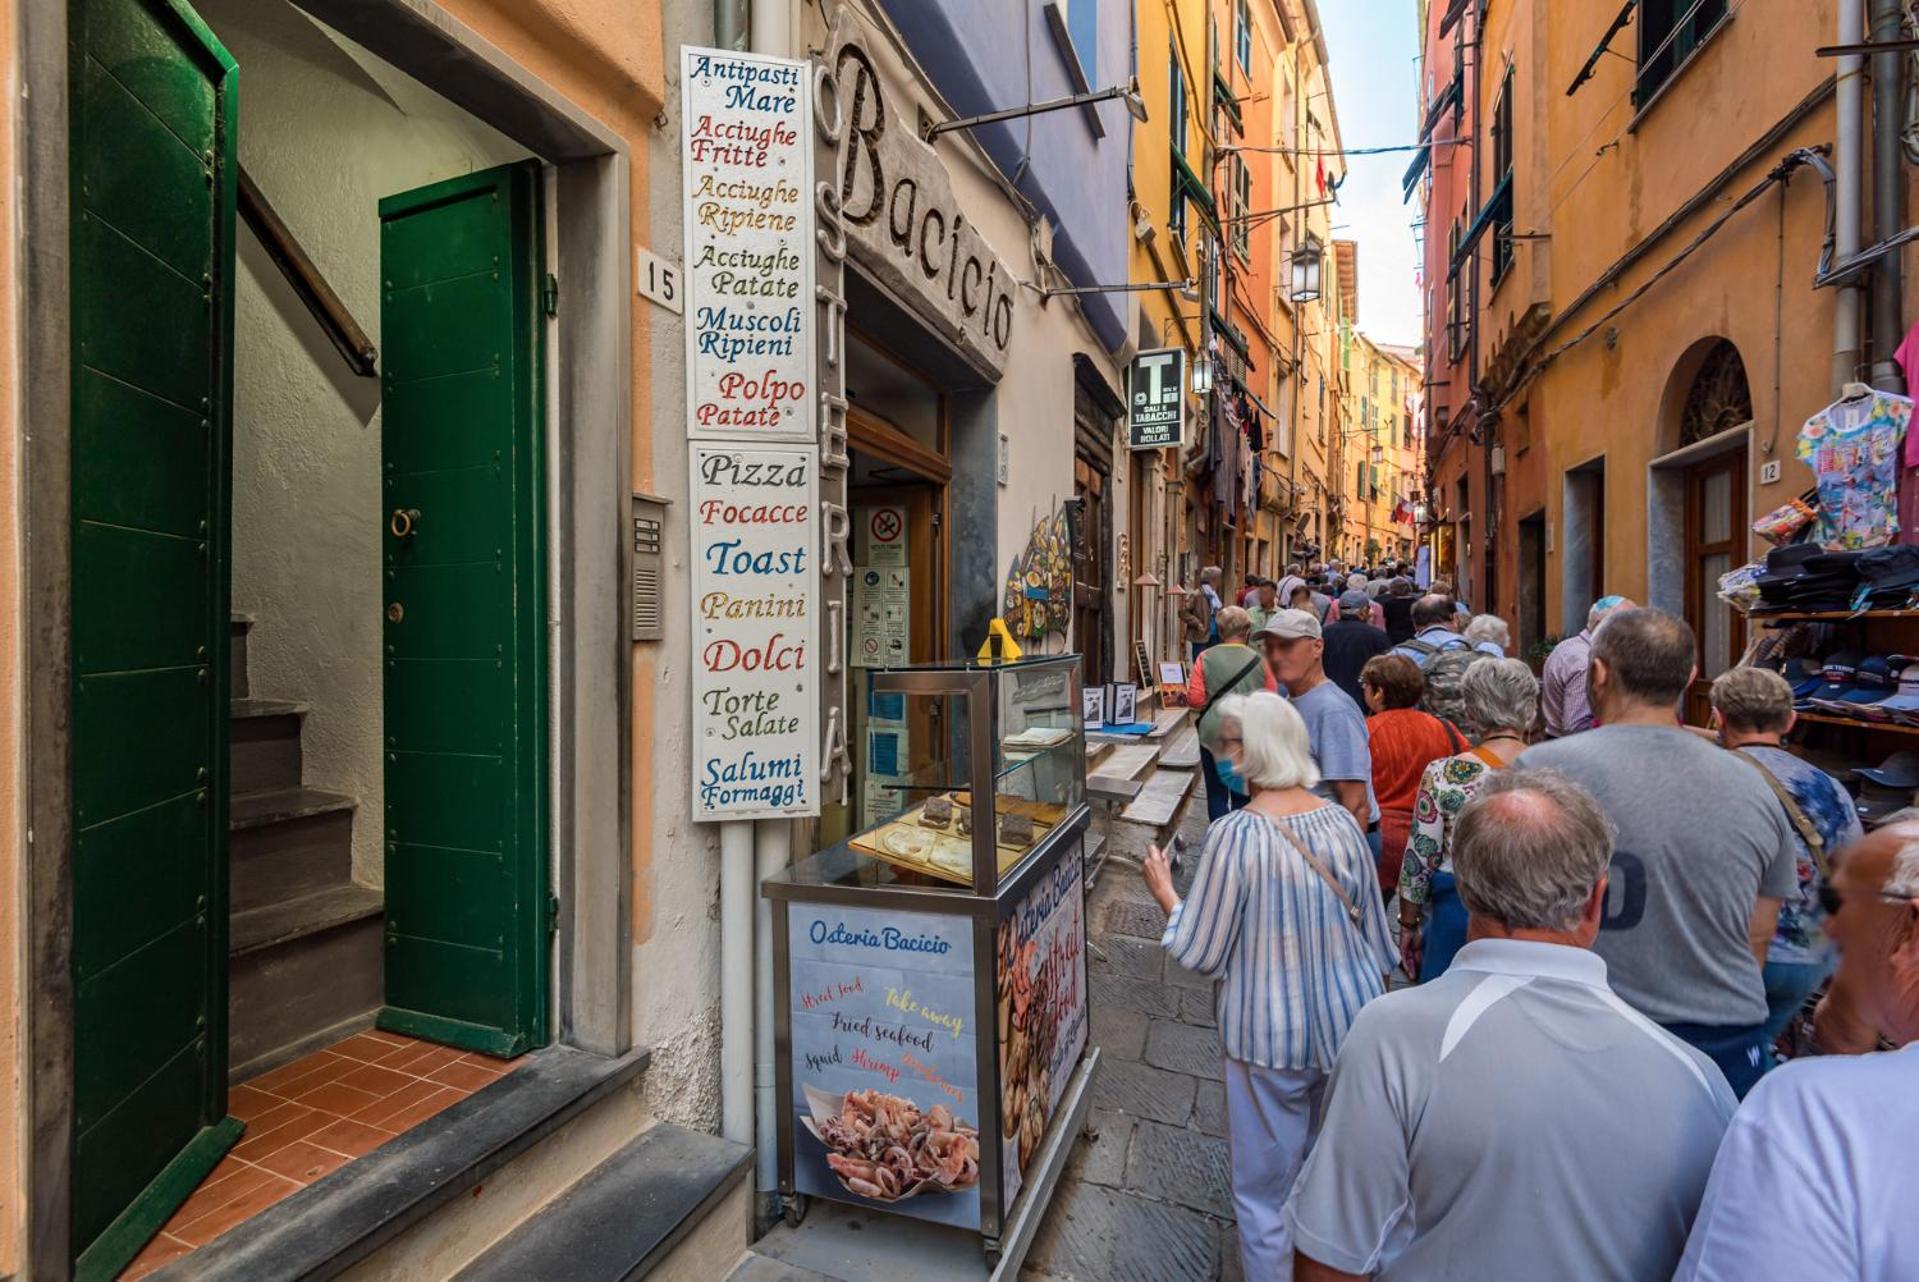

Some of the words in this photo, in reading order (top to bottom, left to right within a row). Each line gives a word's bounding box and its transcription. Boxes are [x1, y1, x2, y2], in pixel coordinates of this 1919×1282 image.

[690, 56, 799, 88] Antipasti
[691, 115, 797, 149] Acciughe
[691, 139, 767, 168] Fritte
[691, 175, 799, 208] Acciughe
[835, 42, 1013, 351] Bacicio
[698, 202, 796, 236] Ripiene
[693, 245, 800, 277] Acciughe
[650, 261, 674, 301] 15
[711, 271, 799, 299] Patate
[697, 306, 801, 333] Muscoli
[698, 331, 793, 362] Ripieni
[719, 369, 805, 409] Polpo
[1139, 354, 1173, 405] T
[697, 403, 781, 427] Patate
[1135, 411, 1177, 423] TABACCHI
[1142, 425, 1168, 434] VALORI
[1140, 433, 1170, 443] BOLLATI
[701, 454, 806, 487] Pizza
[1765, 464, 1776, 480] 12
[700, 500, 808, 525] Focacce
[706, 539, 806, 575] Toast
[700, 592, 806, 620] Panini
[704, 634, 806, 673] Dolci
[703, 687, 780, 716] Torte
[721, 710, 799, 740] Salate
[701, 752, 801, 787] Salumi
[701, 780, 804, 807] Formaggi
[810, 920, 881, 948] Osteria
[881, 927, 953, 954] Bacicio
